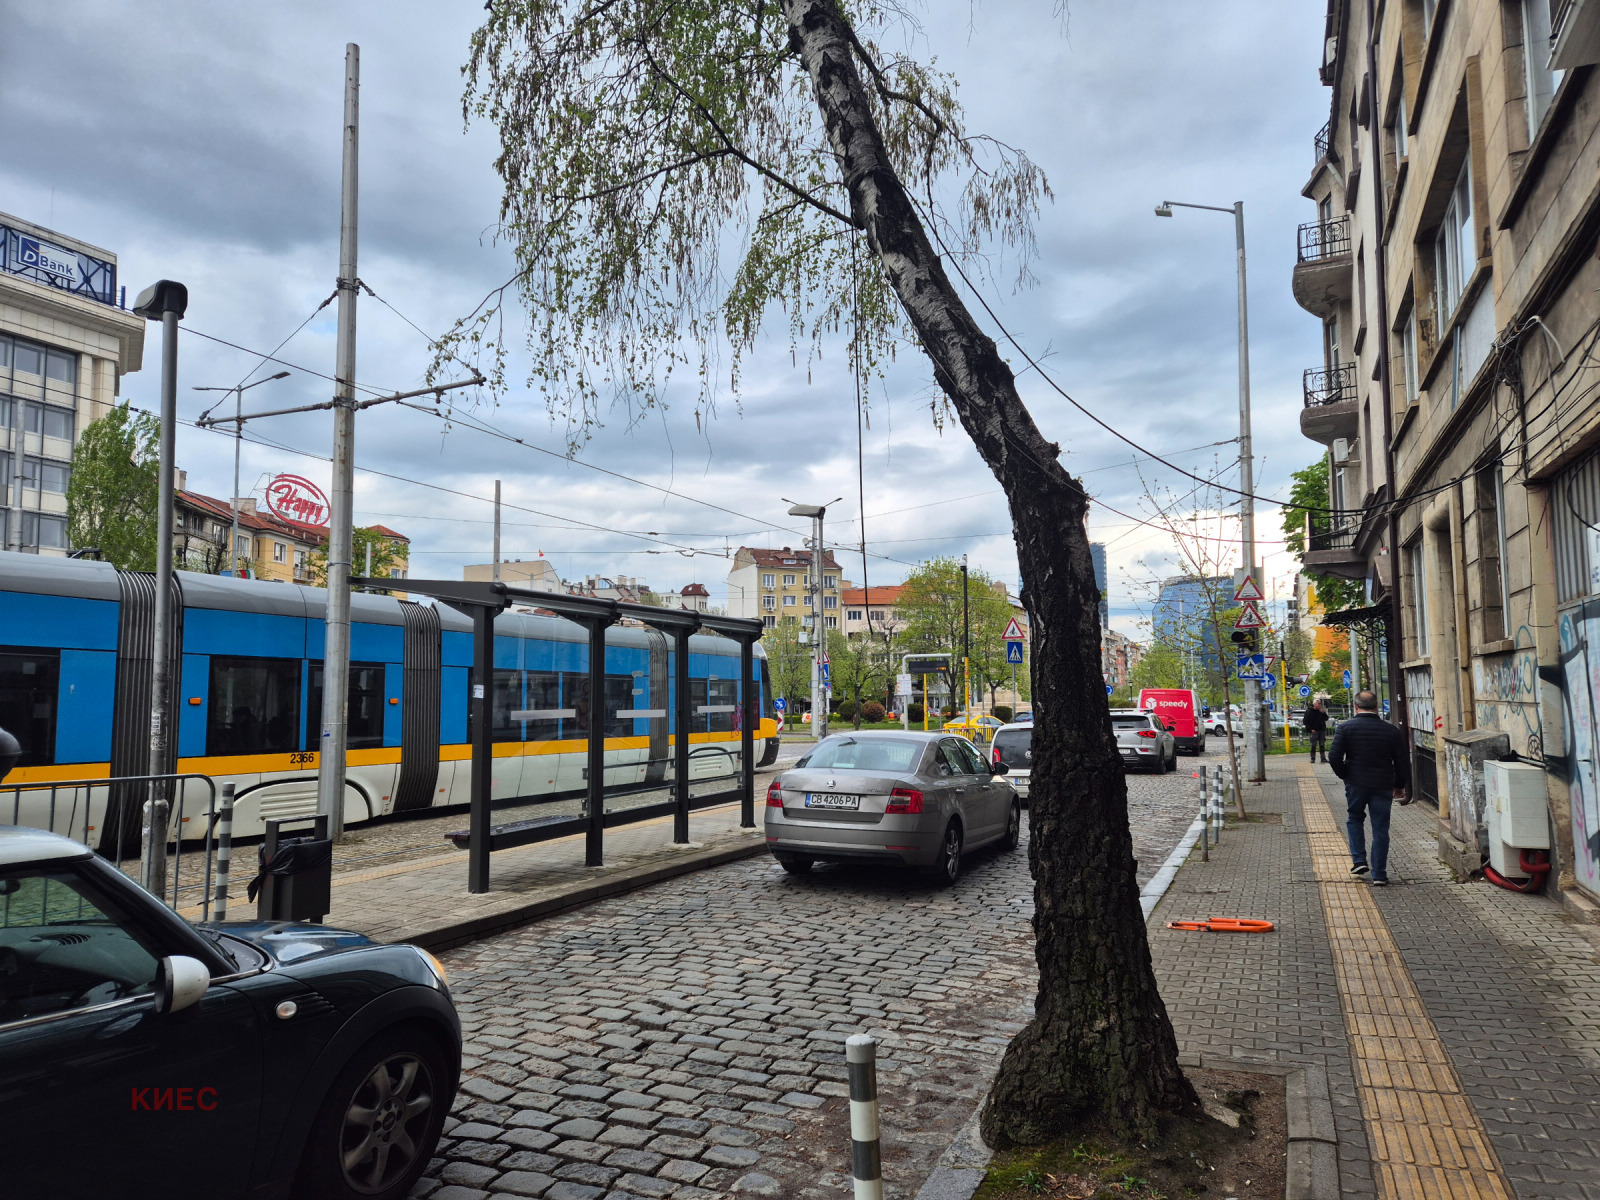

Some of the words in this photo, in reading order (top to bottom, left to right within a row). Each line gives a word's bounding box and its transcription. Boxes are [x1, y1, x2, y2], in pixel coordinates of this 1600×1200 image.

[23, 250, 37, 263] D
[40, 255, 73, 276] Bank
[273, 484, 325, 525] Happy
[1159, 700, 1188, 709] speedy
[290, 753, 314, 764] 2366
[811, 794, 822, 804] CB
[823, 795, 844, 805] 4206
[845, 796, 857, 806] PA
